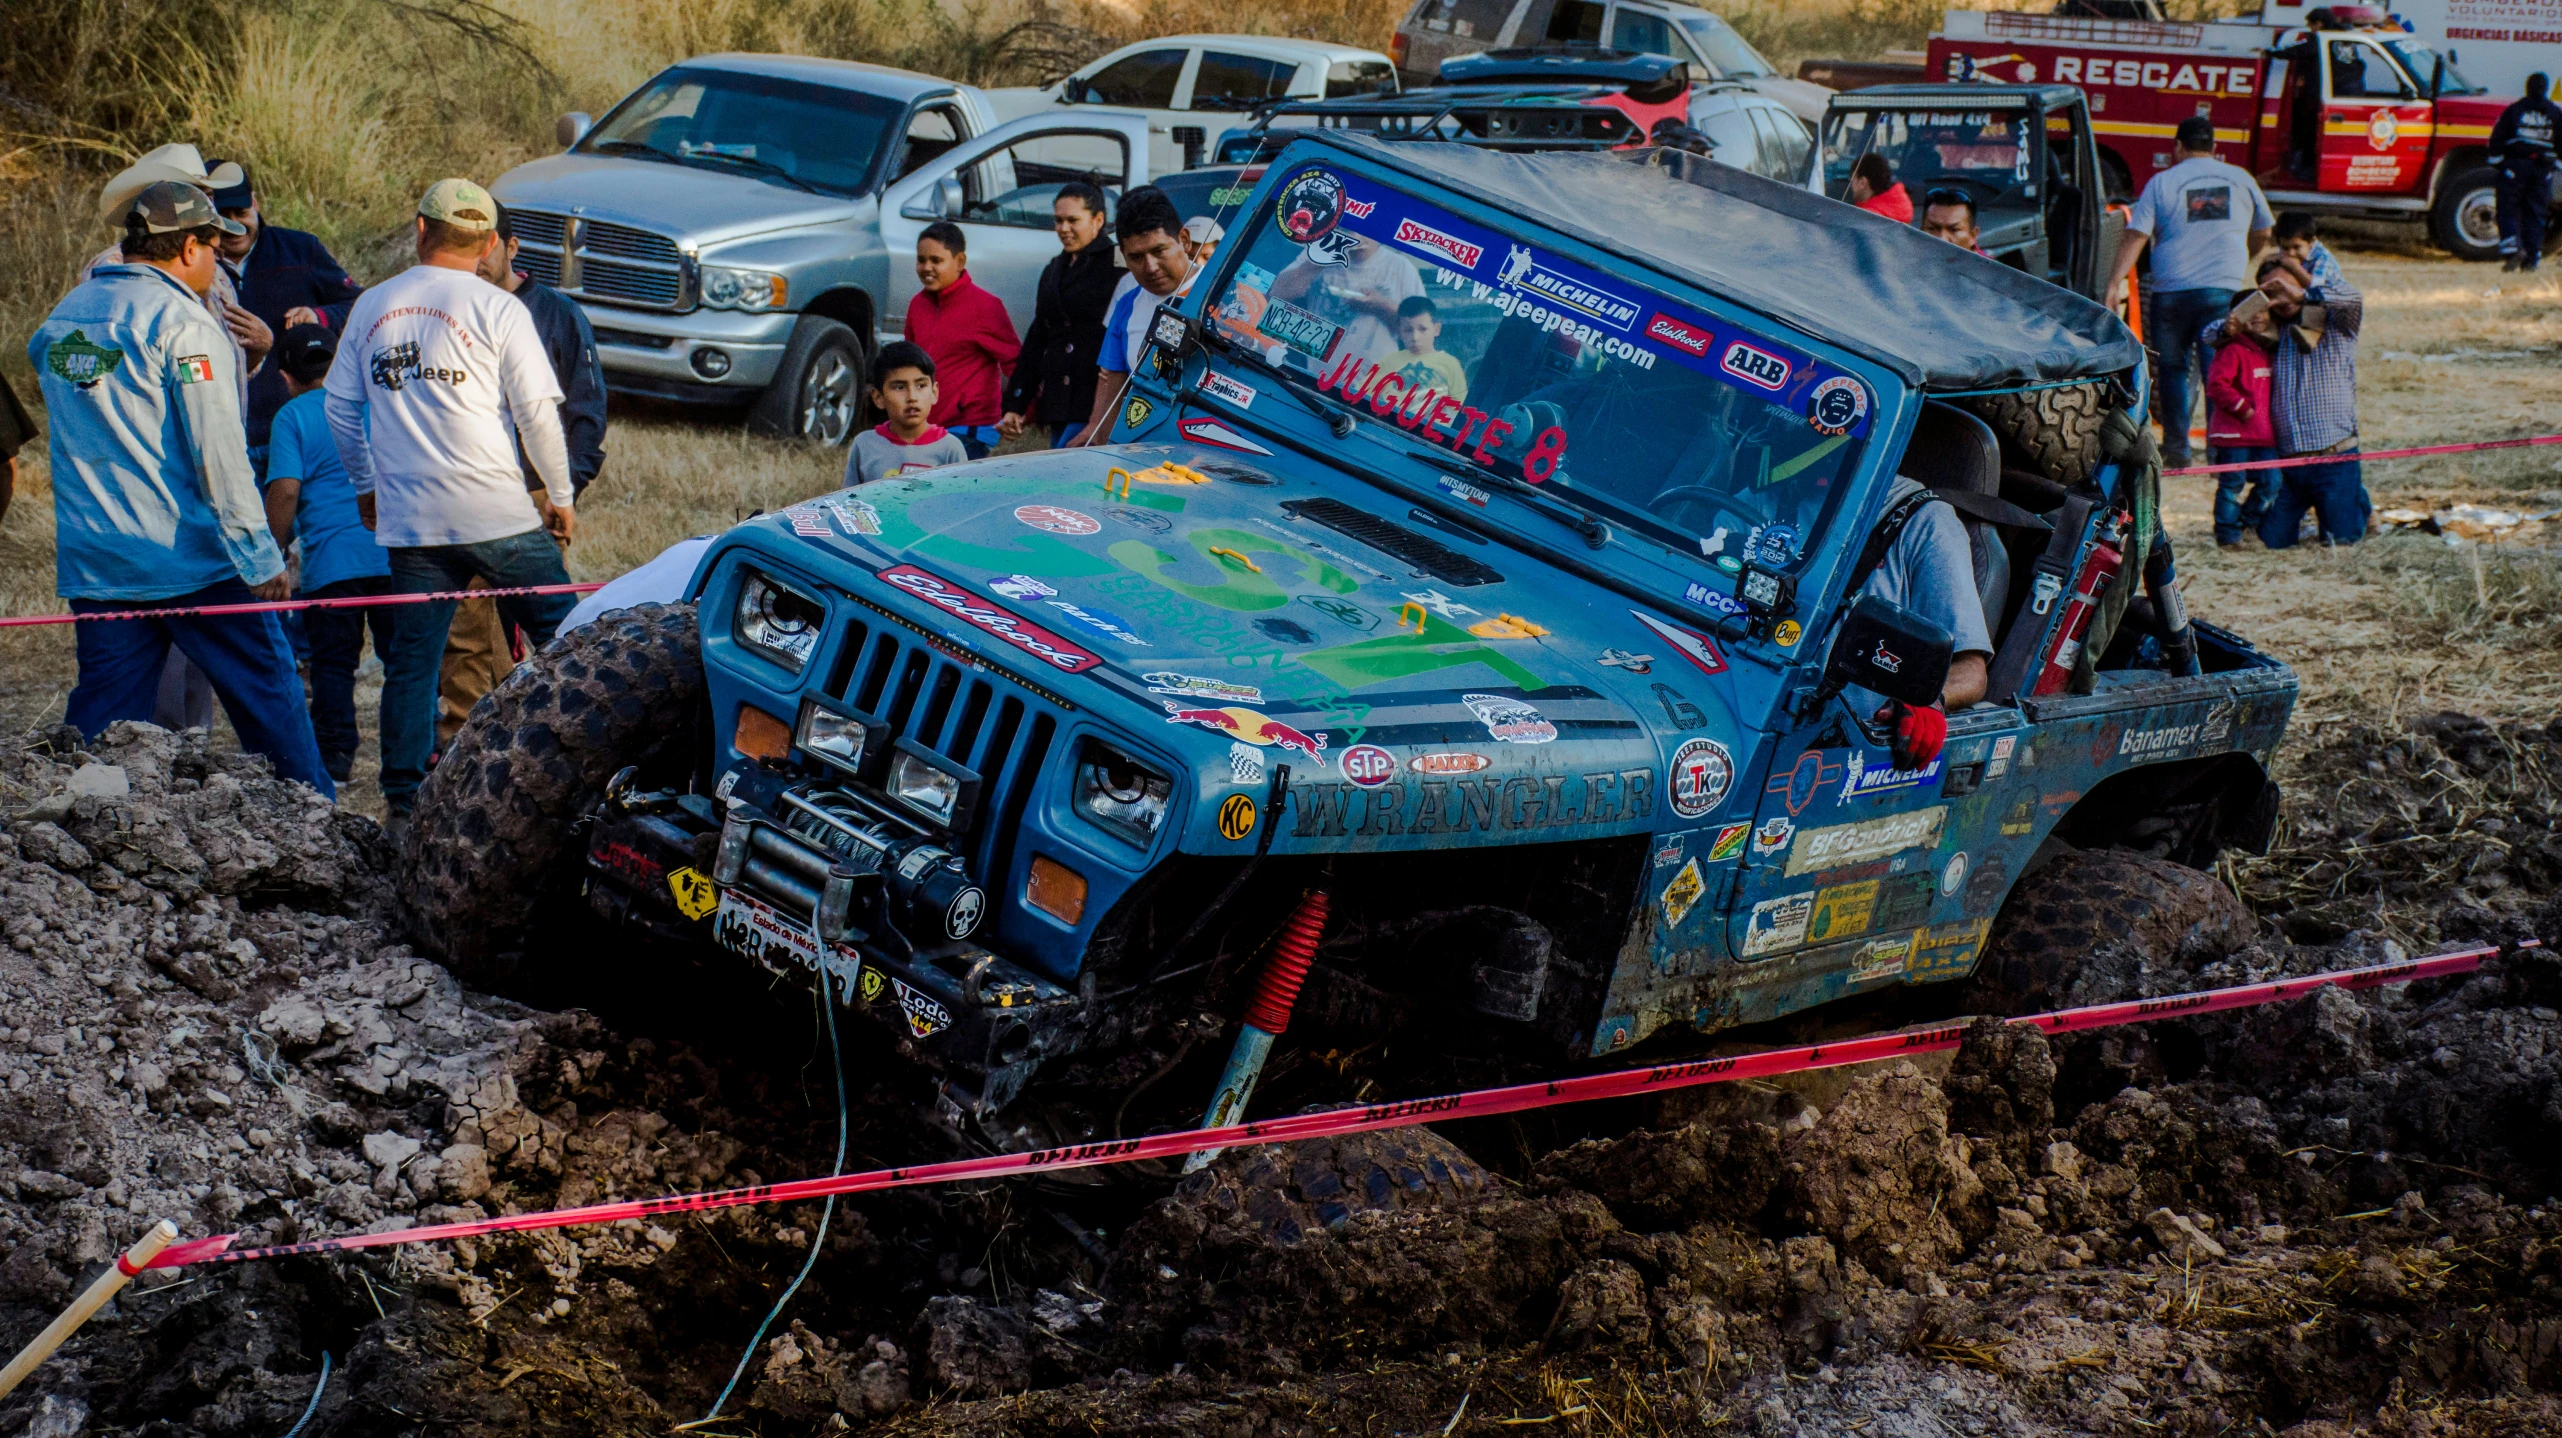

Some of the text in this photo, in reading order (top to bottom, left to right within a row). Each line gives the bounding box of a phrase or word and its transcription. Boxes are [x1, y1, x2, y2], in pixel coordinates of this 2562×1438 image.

[2449, 6, 2562, 18] VOLUNTARIO
[2446, 27, 2510, 41] URGENCIAS
[2053, 56, 2255, 94] RESCATE
[1323, 171, 1341, 188] 2017
[1396, 221, 1481, 268] SKYJACKER
[1530, 273, 1635, 322] MICHELIN
[366, 306, 427, 343] COMPETENCIA
[1261, 304, 1331, 352] NCB-42-23
[1651, 320, 1706, 351] Edelbrock
[412, 363, 466, 386] Jeep
[1727, 347, 1786, 384] ARB
[1817, 378, 1866, 411] JEEPEROS
[1317, 353, 1568, 484] JUGUETE 8
[1440, 475, 1491, 503] #ITSMYTOUR
[1040, 508, 1092, 529] NGK
[888, 574, 1086, 669] Edelbrock
[1776, 624, 1800, 640] Buff
[1873, 656, 1898, 672] GAMES
[1677, 742, 1728, 763] JEEP STUDIO
[2120, 725, 2200, 755] Banamex
[1350, 750, 1388, 779] STP
[1423, 754, 1478, 772] MAXXIS
[1690, 765, 1711, 794] TK
[1222, 796, 1253, 836] KC
[1288, 766, 1655, 838] WRANGLER
[1808, 815, 1930, 856] BFGoodrich
[753, 912, 781, 935] Estado
[781, 928, 793, 940] de
[904, 988, 949, 1023] Lodo
[911, 1014, 933, 1035] 4x4
